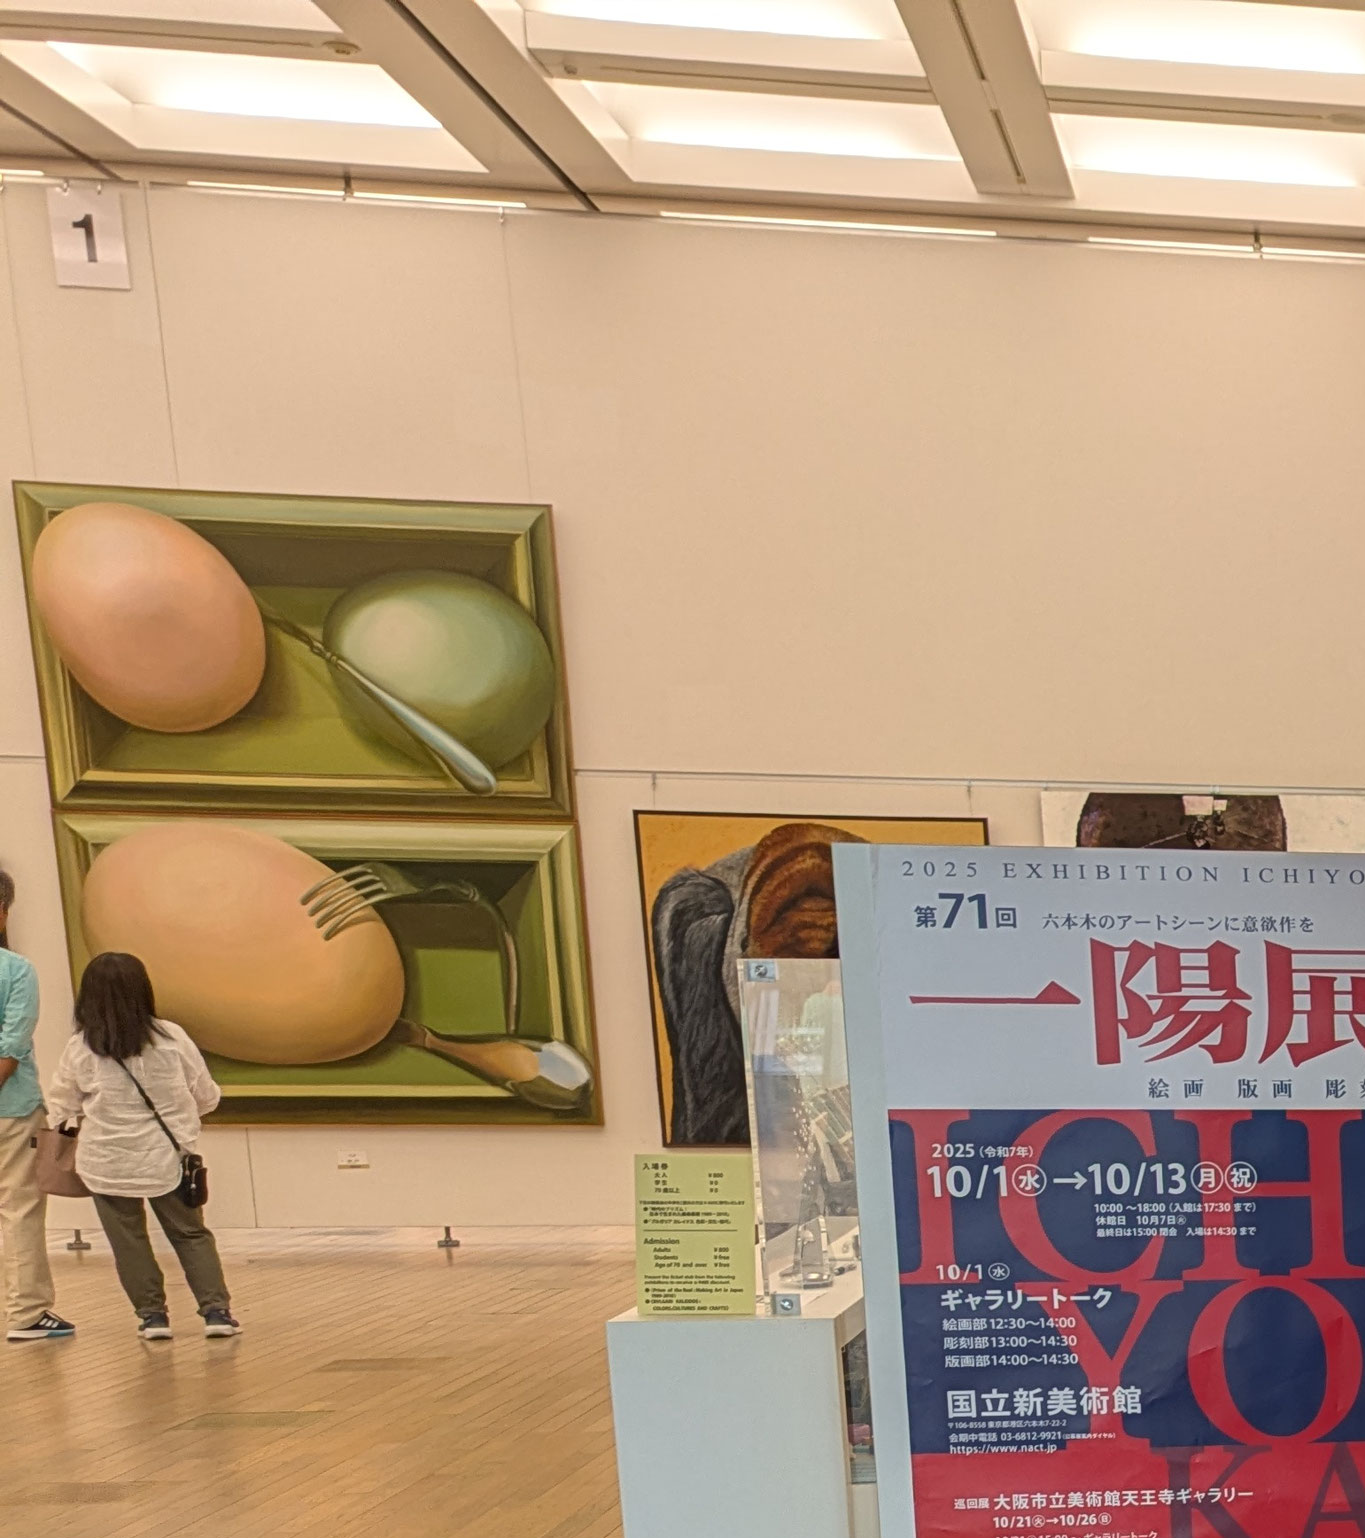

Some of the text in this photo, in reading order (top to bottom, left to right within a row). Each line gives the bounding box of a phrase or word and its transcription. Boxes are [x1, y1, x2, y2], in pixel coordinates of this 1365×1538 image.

[72, 214, 98, 263] 1
[901, 860, 980, 880] 2025
[1002, 862, 1221, 884] EXHIBITION
[913, 892, 1018, 930] 第71回
[1041, 911, 1315, 934] 六本木のアートシーンに意欲作を
[1147, 1077, 1204, 1099] 絵画
[1237, 1077, 1292, 1099] 版画
[931, 1143, 975, 1158] 2025
[1094, 1203, 1123, 1213] 10:00
[1095, 1215, 1127, 1226] 休館日
[643, 1237, 680, 1245] Admission
[940, 1287, 1113, 1311] ギャラリートーク
[947, 1386, 1142, 1418] 国立新美術館
[1001, 1431, 1062, 1441] 03-6812-9921
[949, 1443, 1058, 1456] https://www.nact.jp
[993, 1488, 1254, 1511] 大阪市立美術館天王寺ギャラリー
